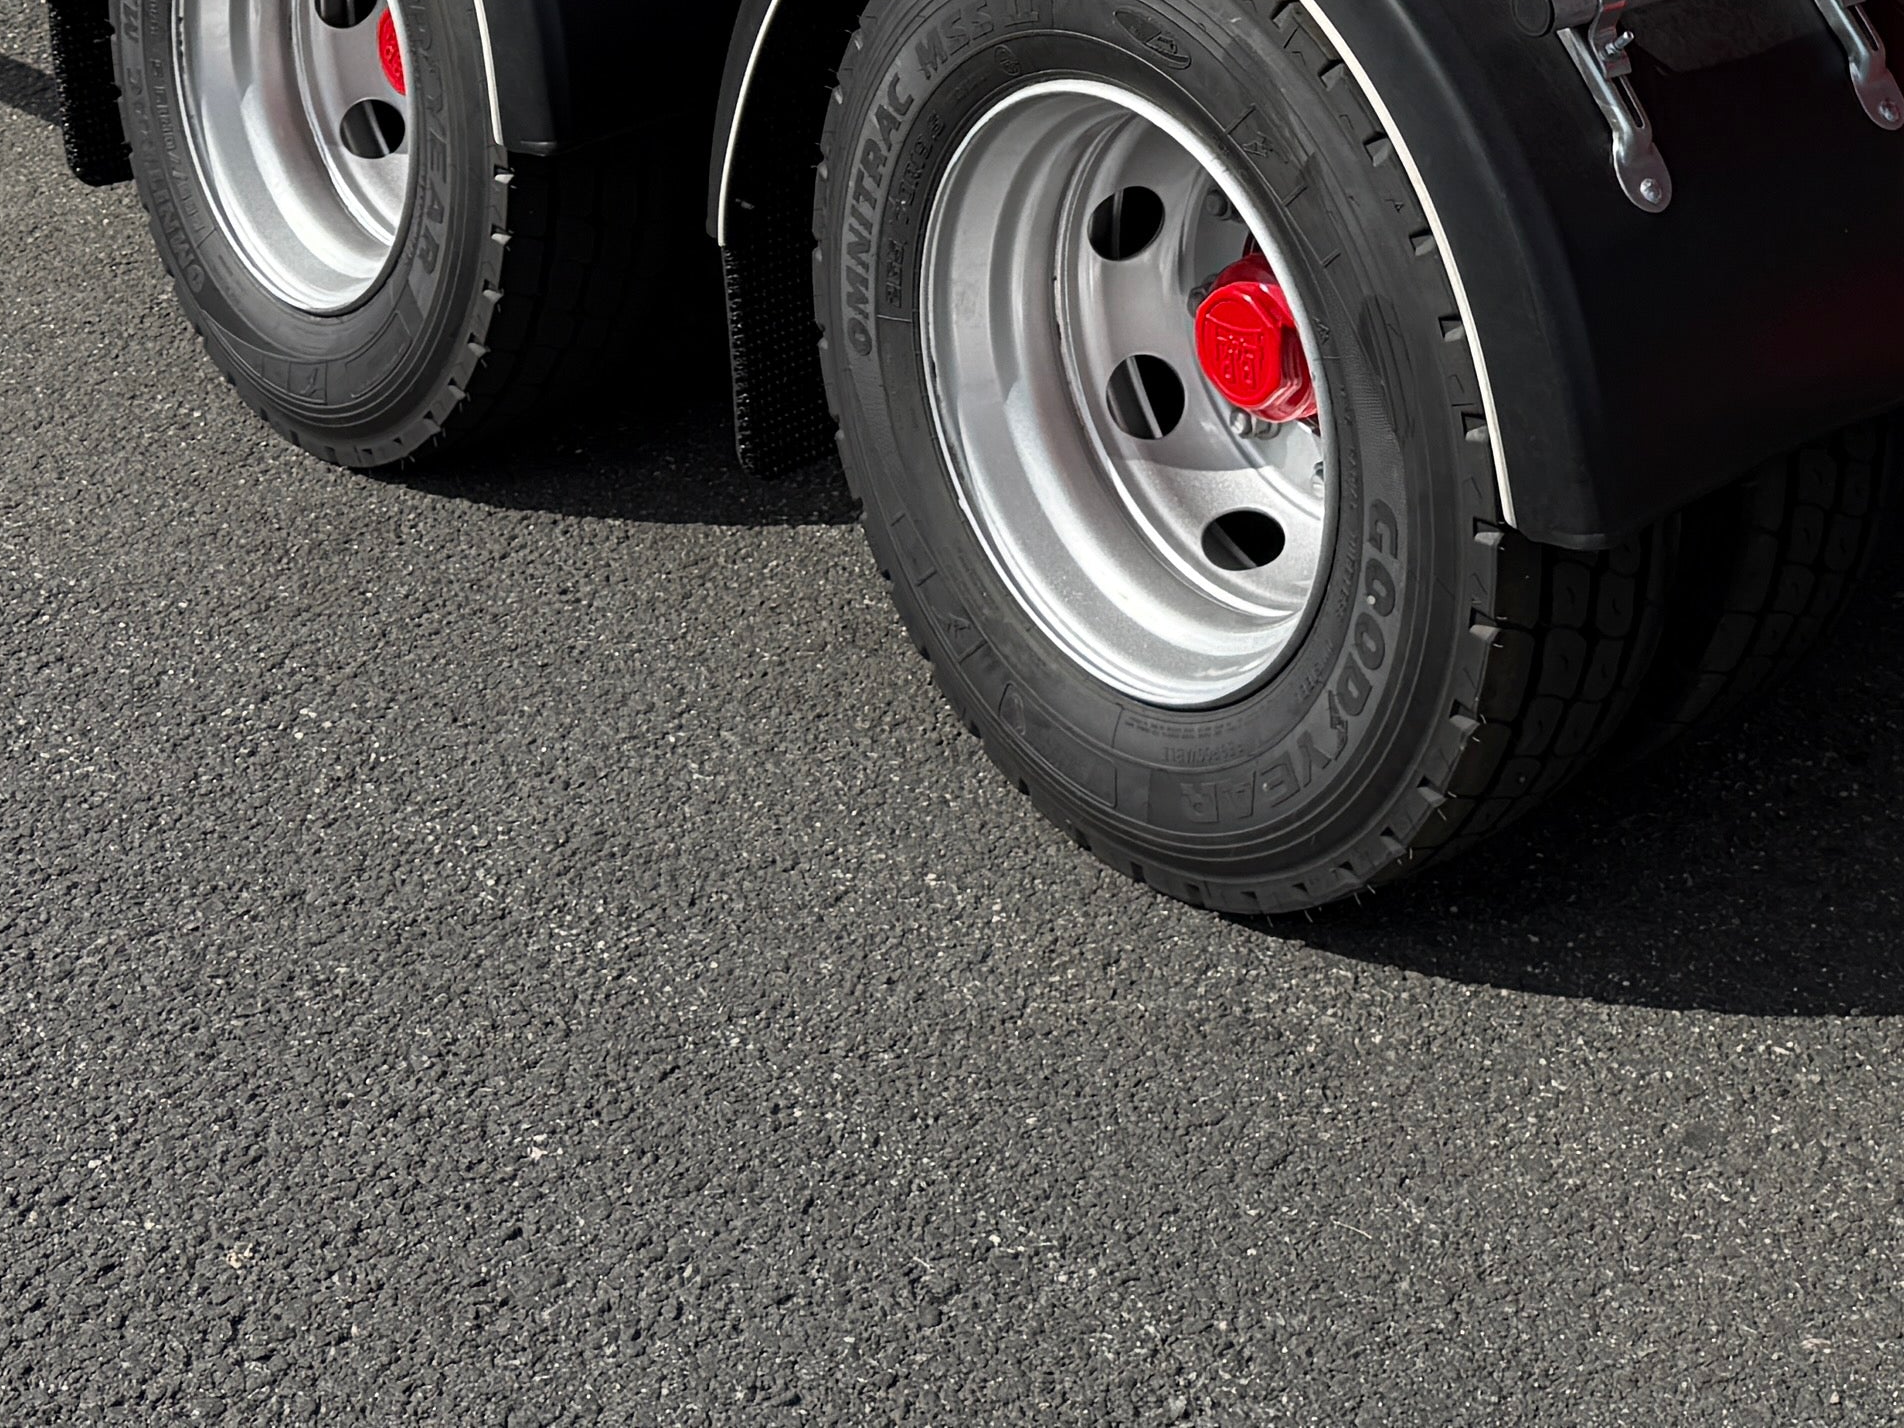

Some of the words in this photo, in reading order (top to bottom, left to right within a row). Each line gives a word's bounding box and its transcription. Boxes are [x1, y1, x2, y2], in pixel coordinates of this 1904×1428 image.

[845, 72, 915, 357] OMNITRAC
[914, 0, 995, 82] MSS
[1180, 498, 1399, 825] GOODYEAR
